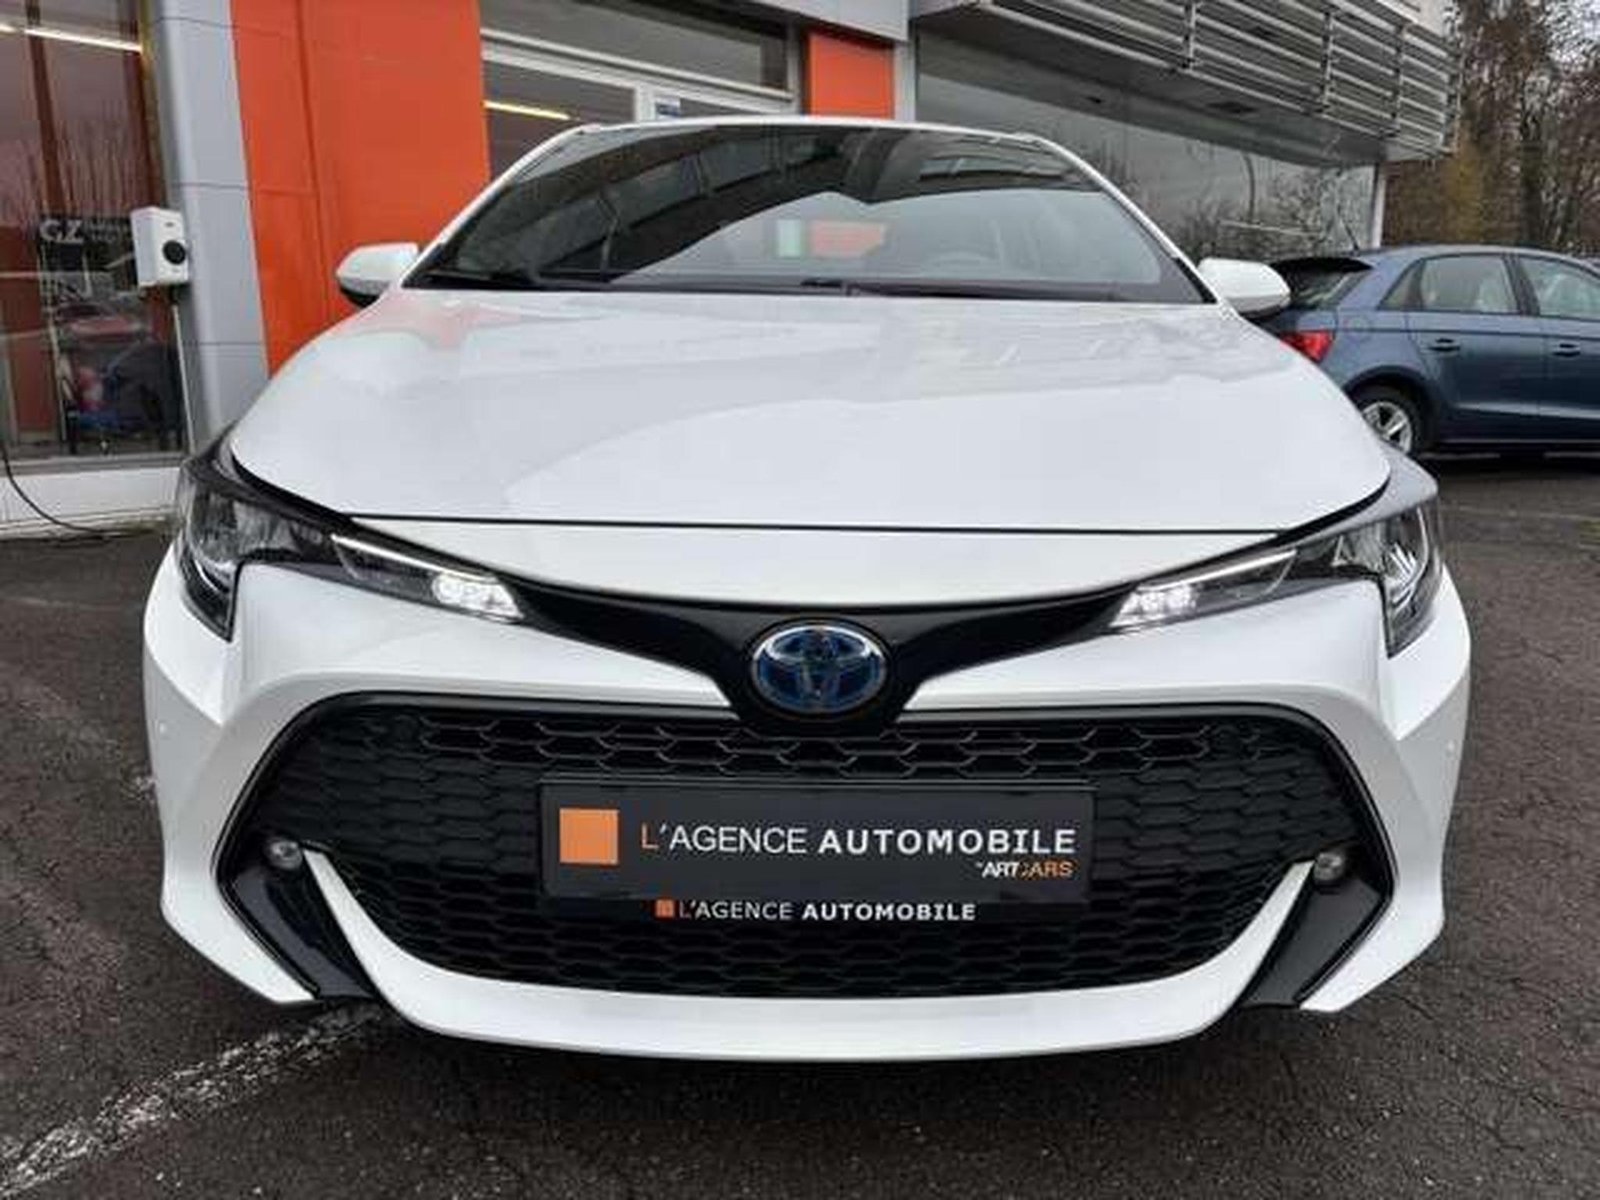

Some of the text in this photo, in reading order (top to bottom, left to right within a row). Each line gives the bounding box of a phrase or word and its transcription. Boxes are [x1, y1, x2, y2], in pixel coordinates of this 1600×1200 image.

[641, 823, 1076, 855] L'AGENCE AUTOMOBILE
[679, 900, 977, 921] L'AGENCE AUTOMOBILE
